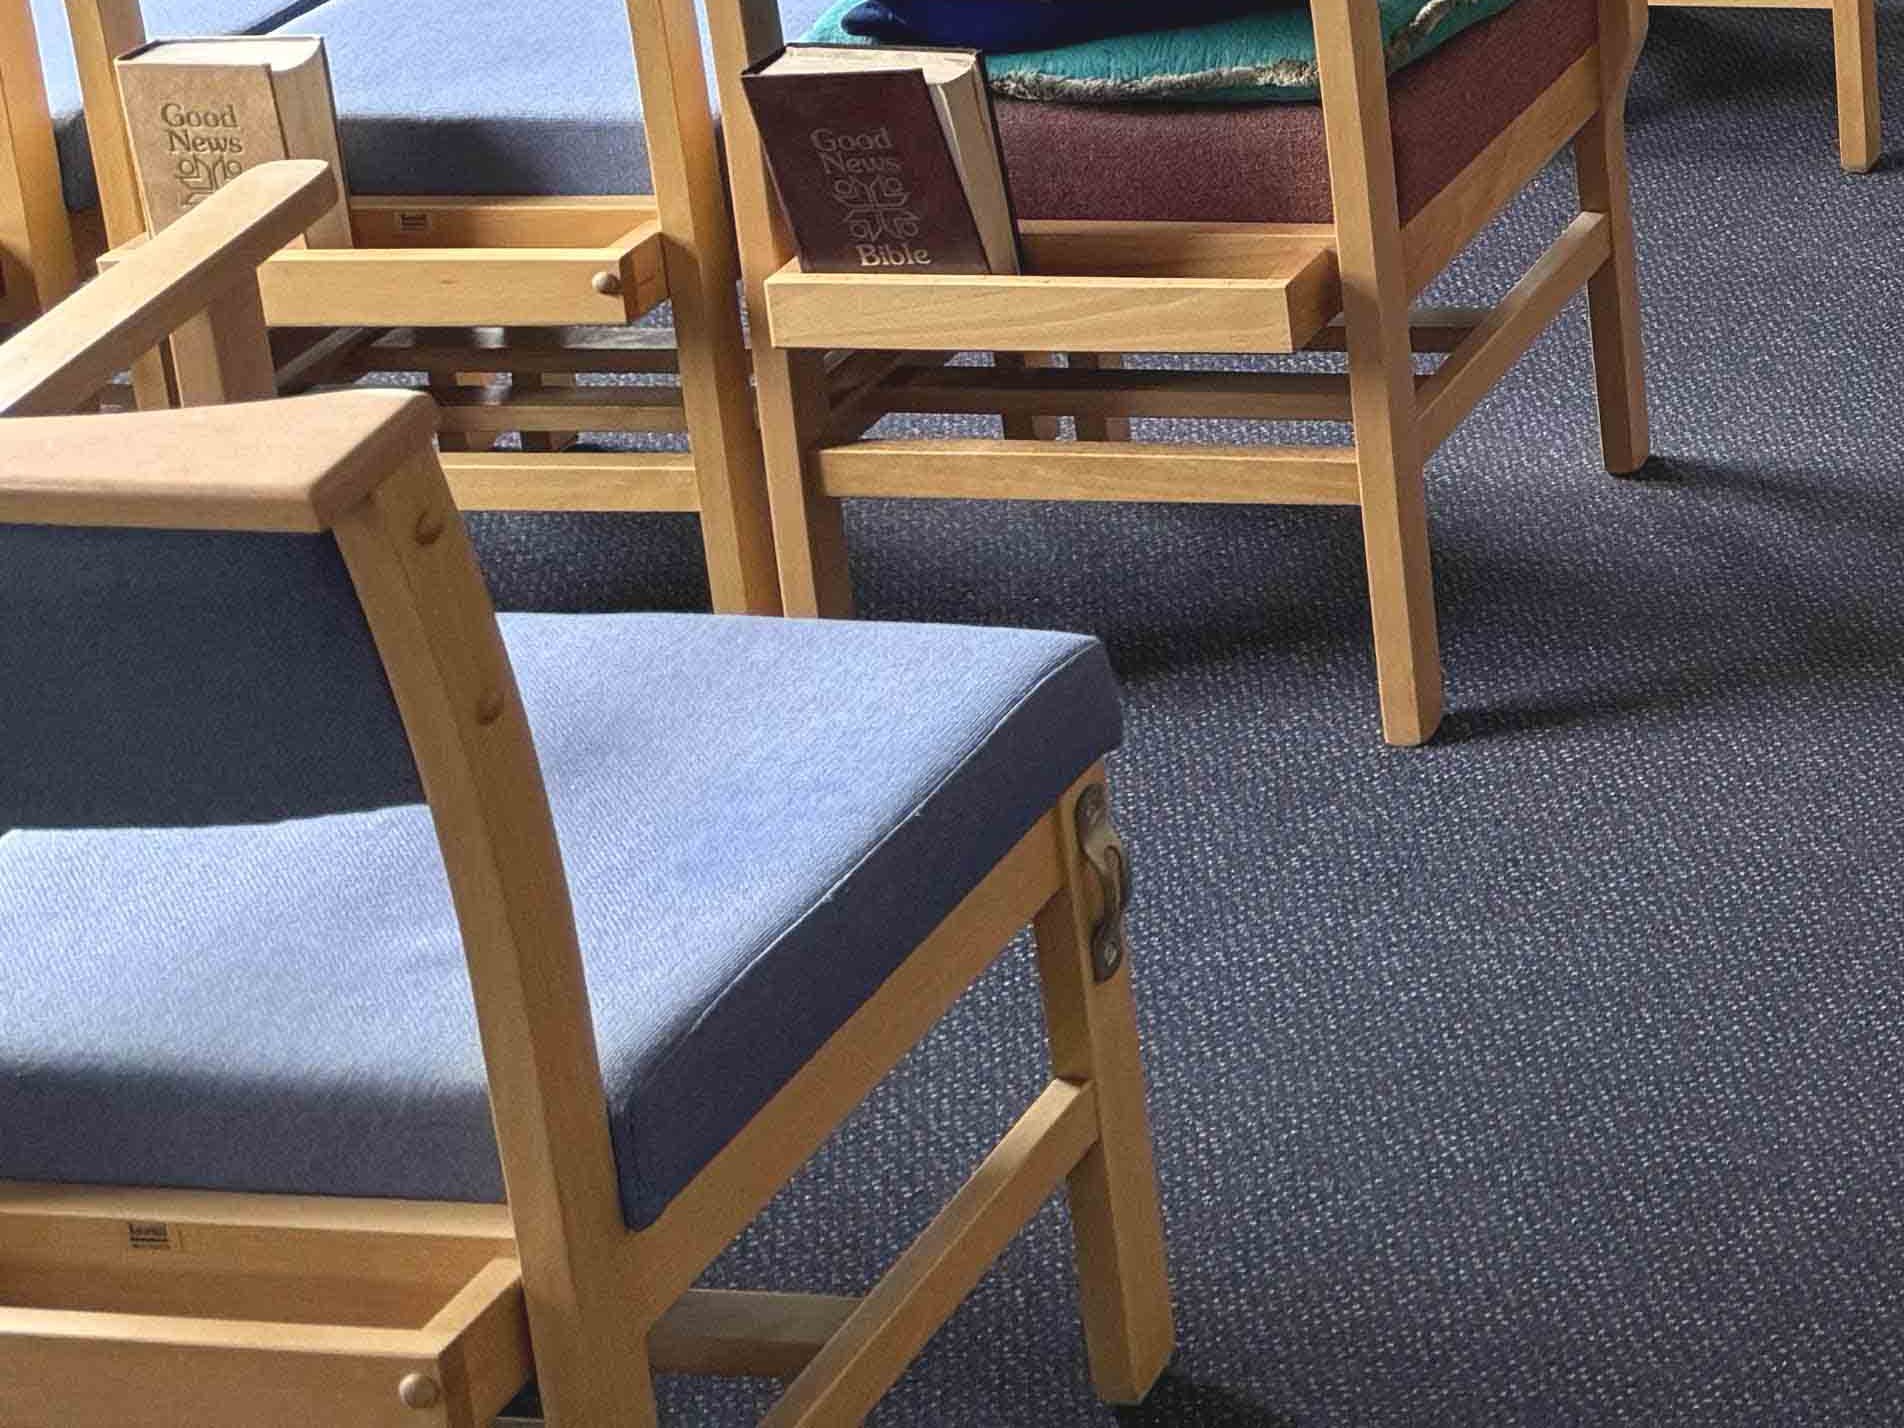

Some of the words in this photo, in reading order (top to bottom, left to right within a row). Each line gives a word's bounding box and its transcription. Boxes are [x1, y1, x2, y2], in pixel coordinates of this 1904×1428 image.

[160, 101, 240, 129] Good
[165, 128, 243, 154] News
[810, 127, 893, 152] Good
[820, 151, 901, 176] News
[855, 244, 932, 267] Bible
